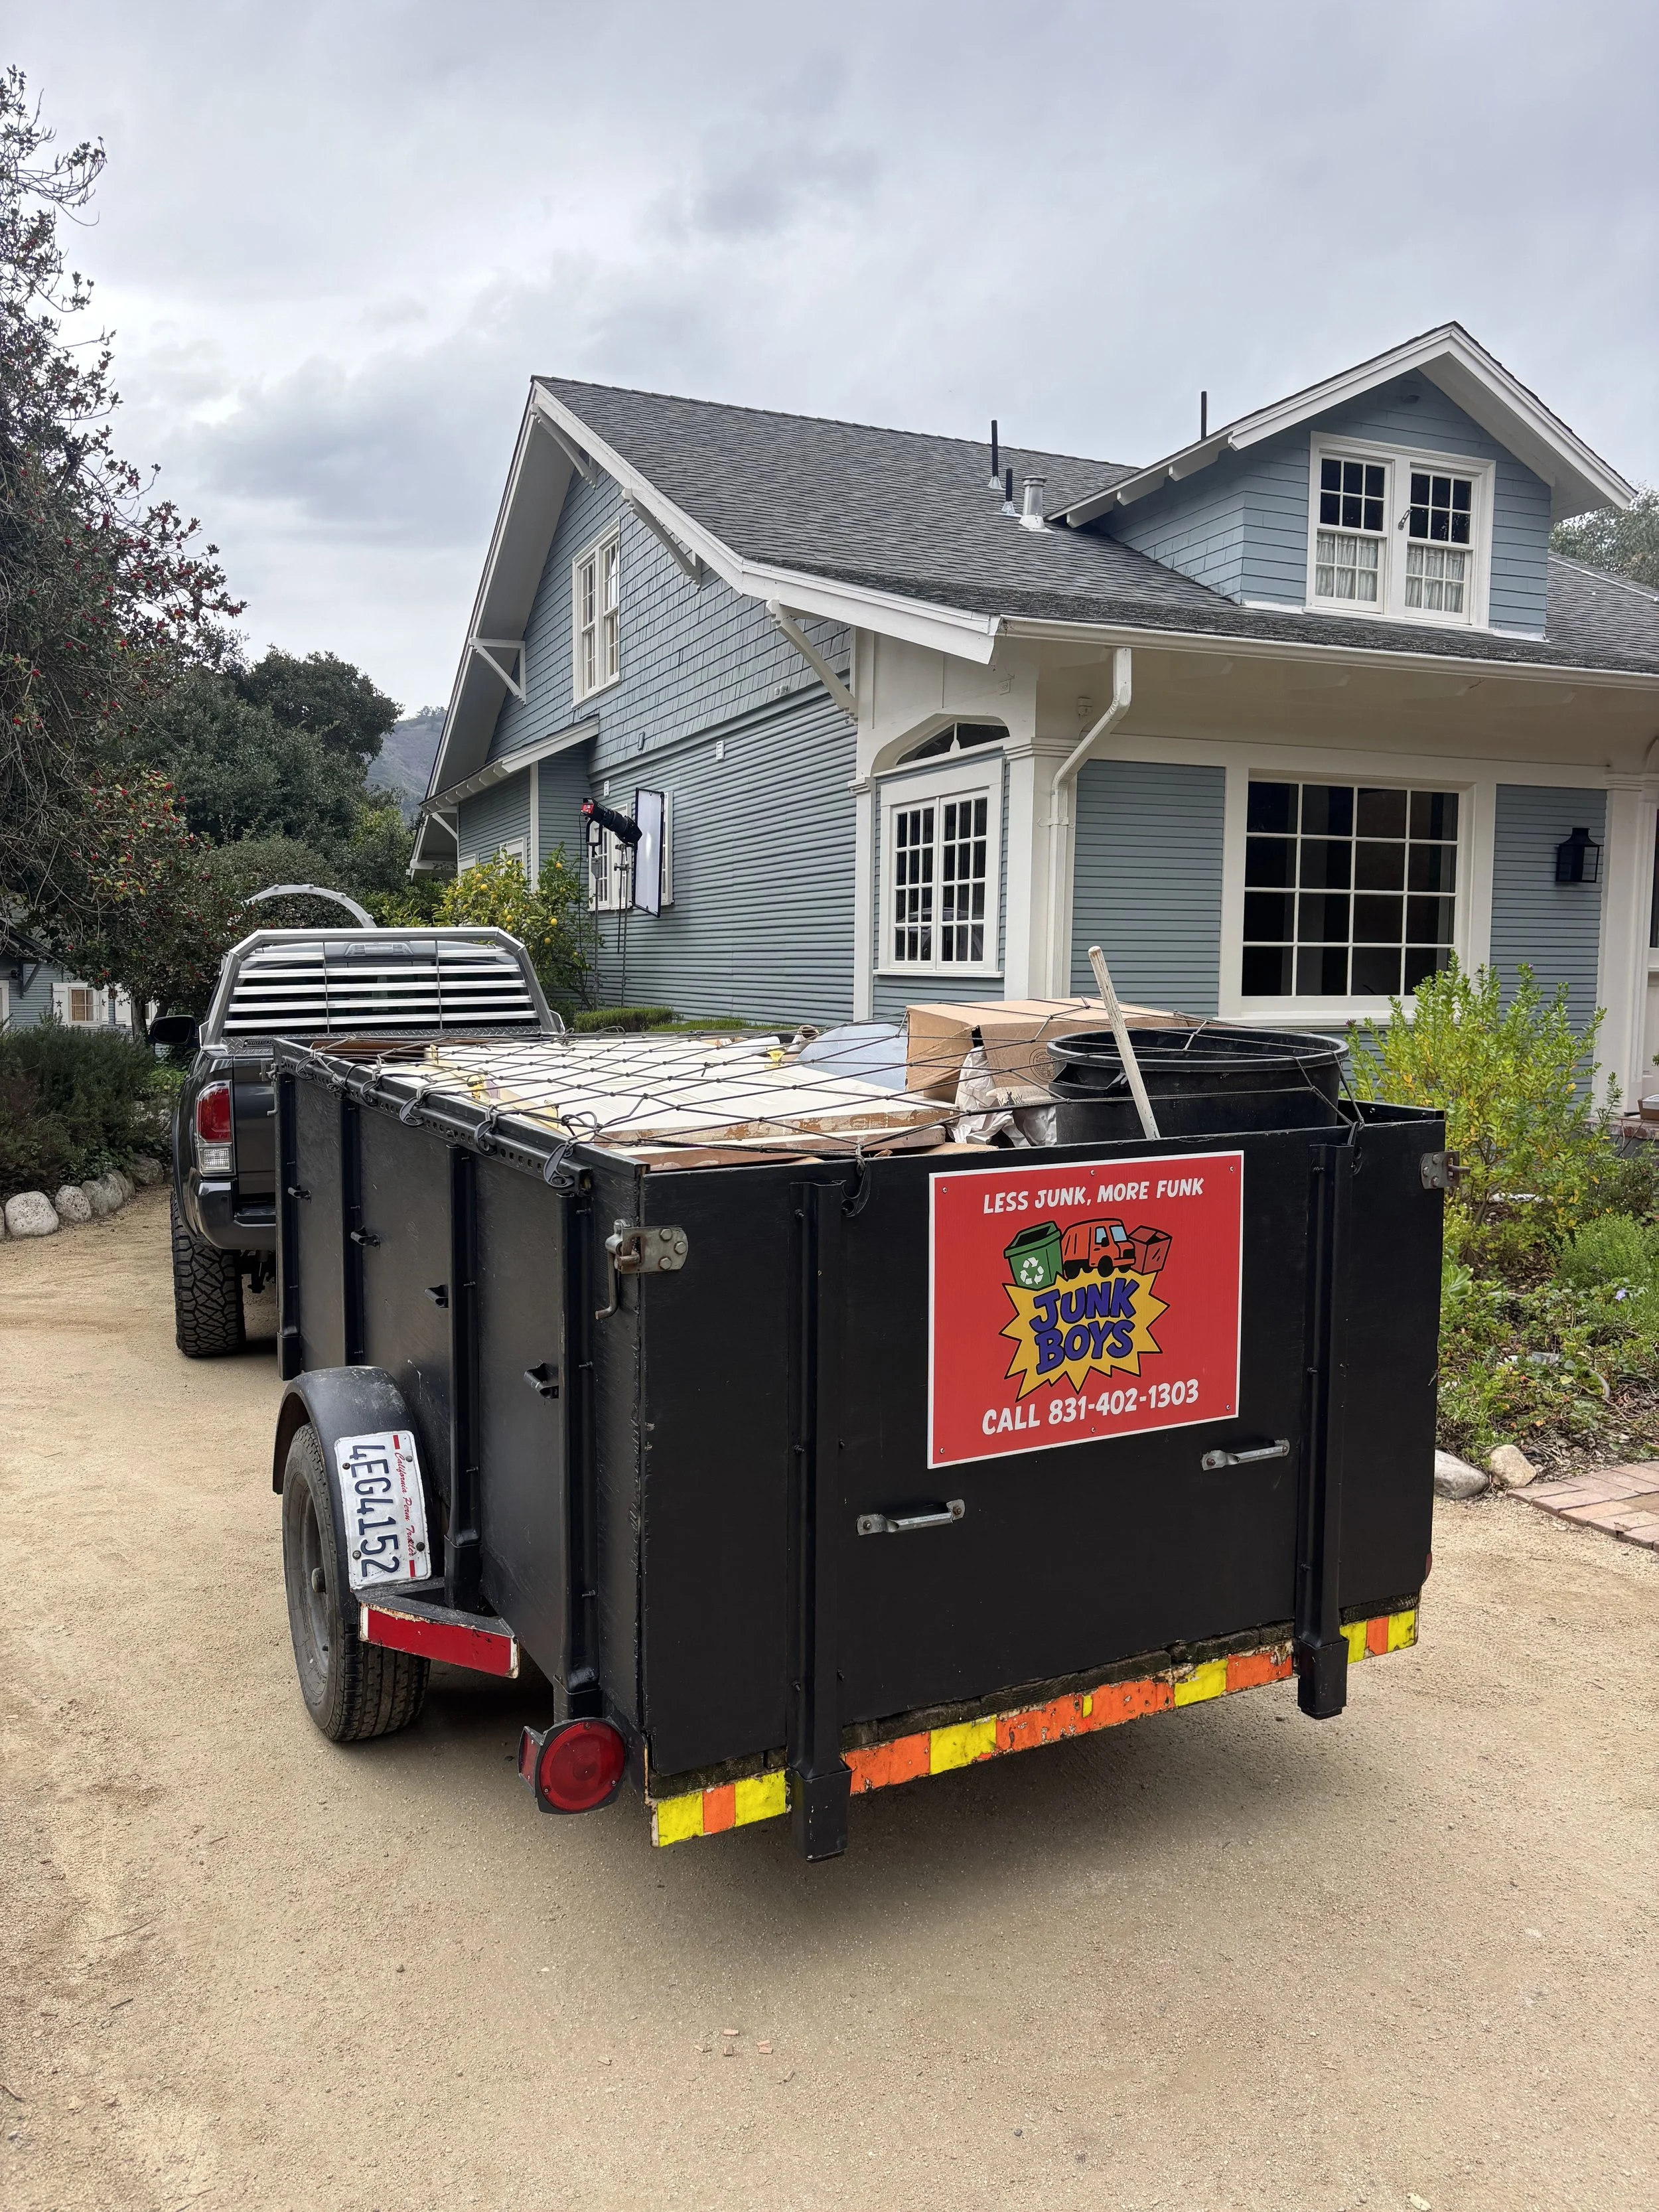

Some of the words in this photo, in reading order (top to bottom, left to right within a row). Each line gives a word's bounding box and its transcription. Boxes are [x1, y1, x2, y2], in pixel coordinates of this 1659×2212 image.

[983, 1191, 1029, 1214] LESS
[1034, 1185, 1092, 1209] JUNK,
[1097, 1181, 1150, 1203] MORE
[1156, 1177, 1204, 1199] FUNK
[1029, 1278, 1139, 1332] JUNK
[1035, 1319, 1135, 1374] BOYS
[981, 1404, 1041, 1436] CALL
[1048, 1378, 1199, 1425] 831-402-1303
[349, 1445, 399, 1578] 4EG4152
[394, 1452, 407, 1494] California
[403, 1497, 413, 1522] Perm
